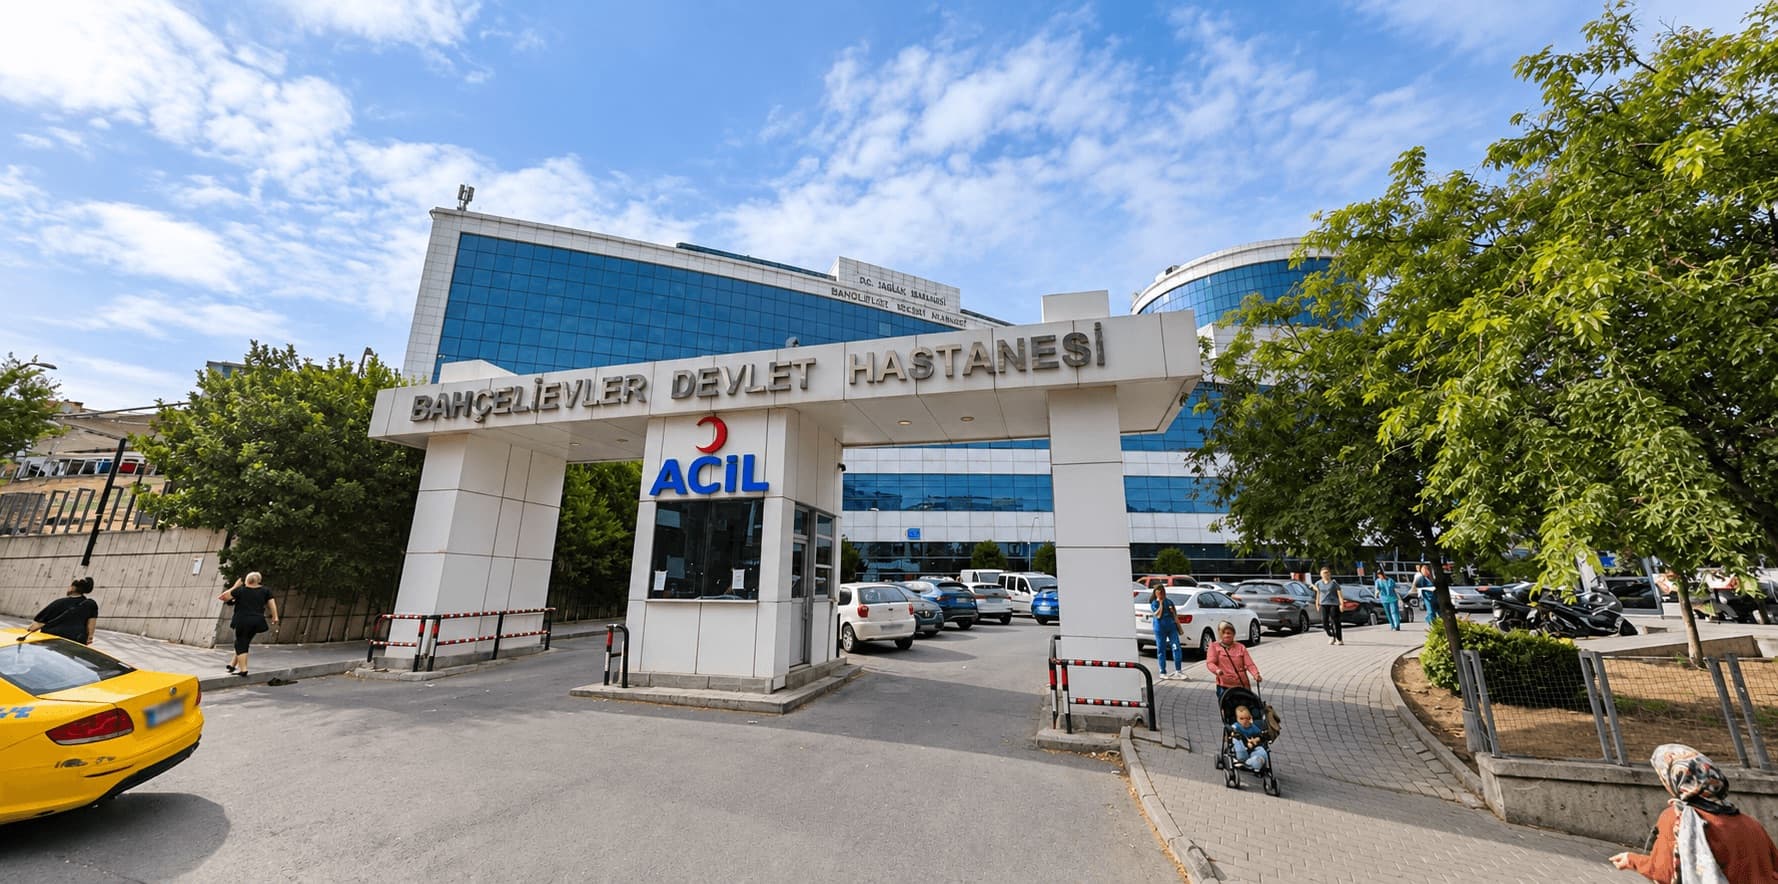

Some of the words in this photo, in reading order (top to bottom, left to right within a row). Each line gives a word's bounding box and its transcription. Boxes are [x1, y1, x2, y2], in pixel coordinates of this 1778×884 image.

[410, 374, 647, 422] BAHÇELİEVLER
[671, 358, 816, 400] DEVLET
[849, 322, 1105, 384] HASTANESİ
